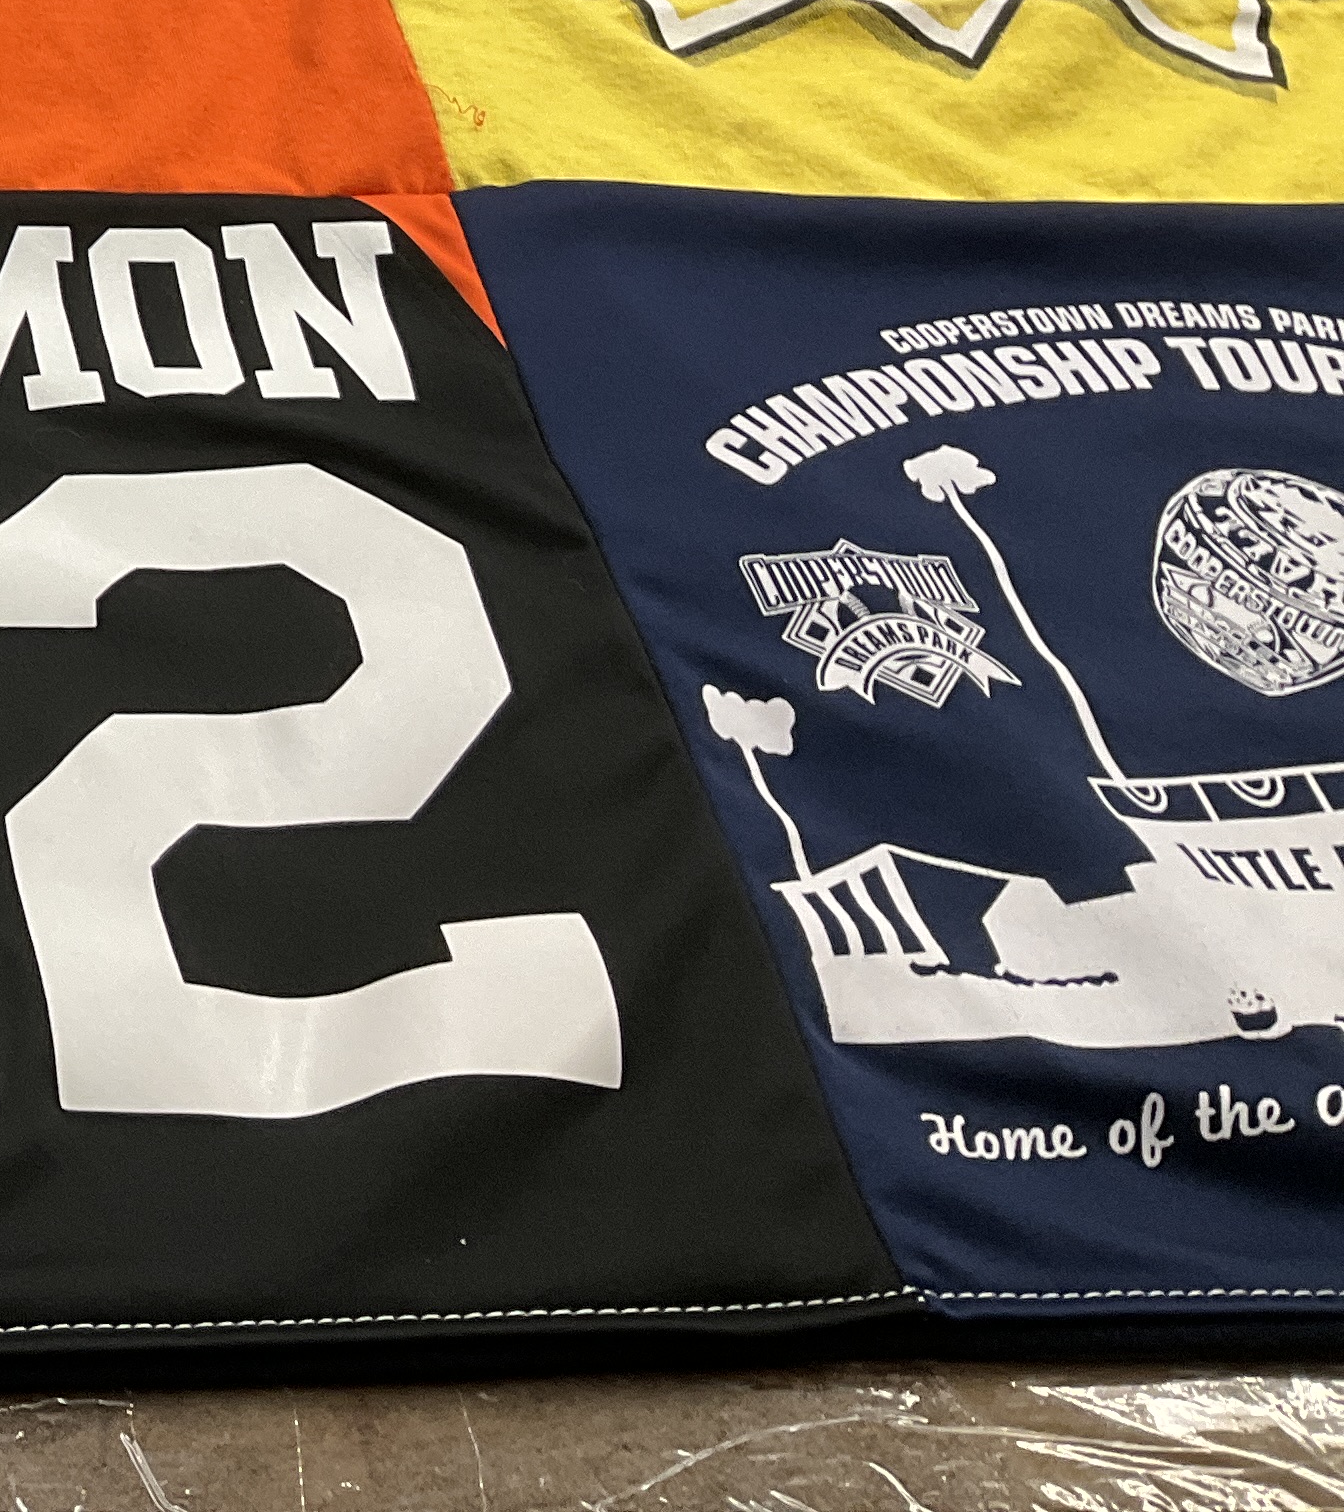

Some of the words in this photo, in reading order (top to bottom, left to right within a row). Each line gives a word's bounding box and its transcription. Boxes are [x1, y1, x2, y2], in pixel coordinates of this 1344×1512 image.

[880, 302, 1114, 354] COOPERSTOWN
[1115, 300, 1262, 331] DREAMS
[705, 337, 1163, 486] CHAMPIONSHIP
[835, 620, 913, 672] DREAMS
[915, 624, 974, 665] PARK
[1175, 842, 1333, 891] LITTLE
[920, 1112, 1088, 1160] Home
[1108, 1091, 1175, 1168] of
[1195, 1083, 1297, 1142] the
